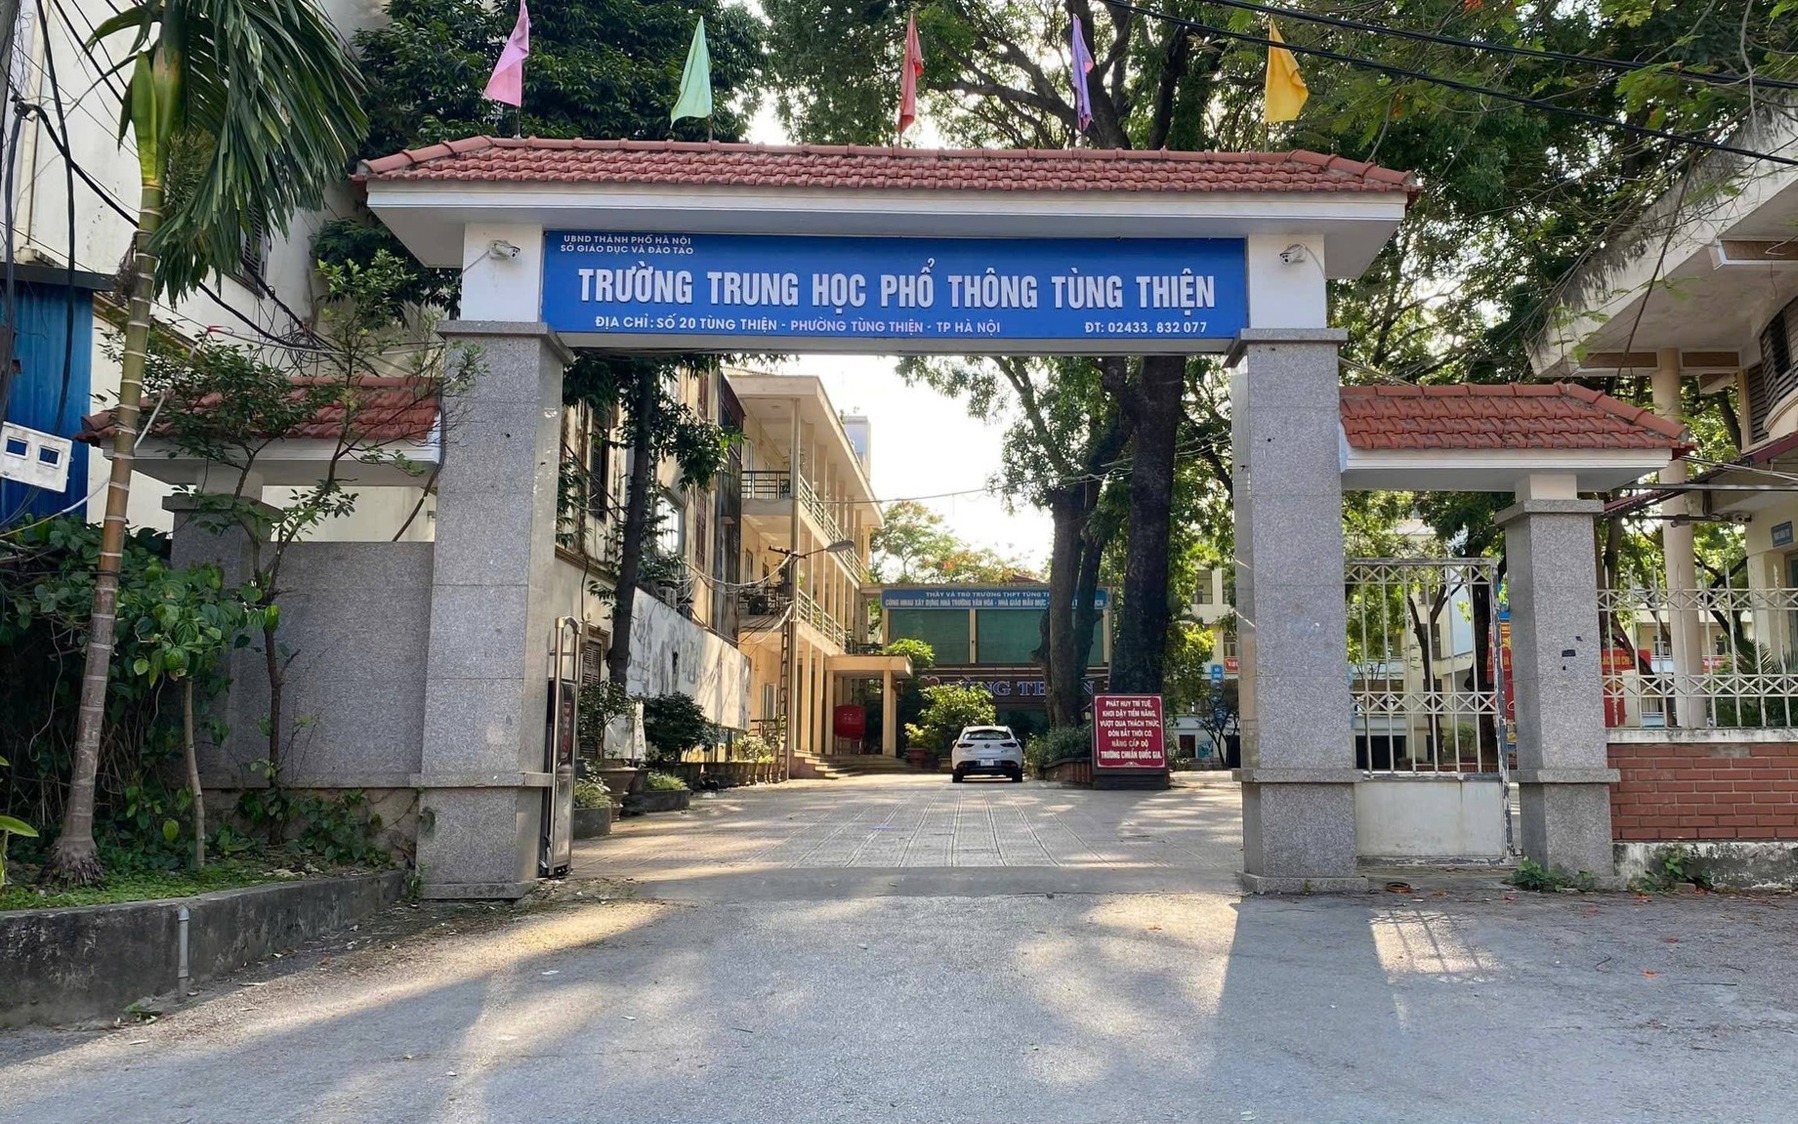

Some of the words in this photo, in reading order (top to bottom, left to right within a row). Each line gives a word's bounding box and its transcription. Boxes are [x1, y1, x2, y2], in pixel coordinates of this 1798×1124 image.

[564, 235, 591, 243] UBND
[594, 234, 629, 244] THÀNH
[631, 234, 653, 244] PHỐ
[655, 235, 670, 245] HÀ
[672, 235, 691, 247] NỘI
[560, 241, 575, 252] SỞ
[577, 243, 604, 253] GIÁO
[606, 245, 629, 255] DỤC
[631, 244, 645, 254] VÀ
[648, 244, 671, 254] ĐÀO
[673, 246, 694, 256] TẠO
[578, 260, 693, 304] TRƯỜNG
[707, 271, 799, 307] TRUNG
[812, 273, 866, 314] HỌC
[880, 258, 935, 308] PHỔ
[948, 267, 1038, 308] THÔNG
[1051, 267, 1123, 309] TÙNG
[1136, 268, 1215, 316] THIỆN
[595, 316, 620, 330] ĐỊA
[656, 313, 677, 329] SỐ
[679, 316, 696, 329] 20
[699, 315, 736, 330] TÙNG
[740, 316, 777, 333] THIỆN
[791, 317, 847, 331] PHƯỜNG
[851, 318, 886, 332] TÙNG
[889, 319, 924, 335] THIỆN
[936, 322, 951, 333] TP
[954, 319, 973, 333] HÀ
[977, 319, 1000, 336] NỘI
[1085, 321, 1104, 333] ĐT:
[1108, 322, 1152, 333] 02433.
[1156, 321, 1180, 333] 832
[1183, 321, 1207, 333] 077
